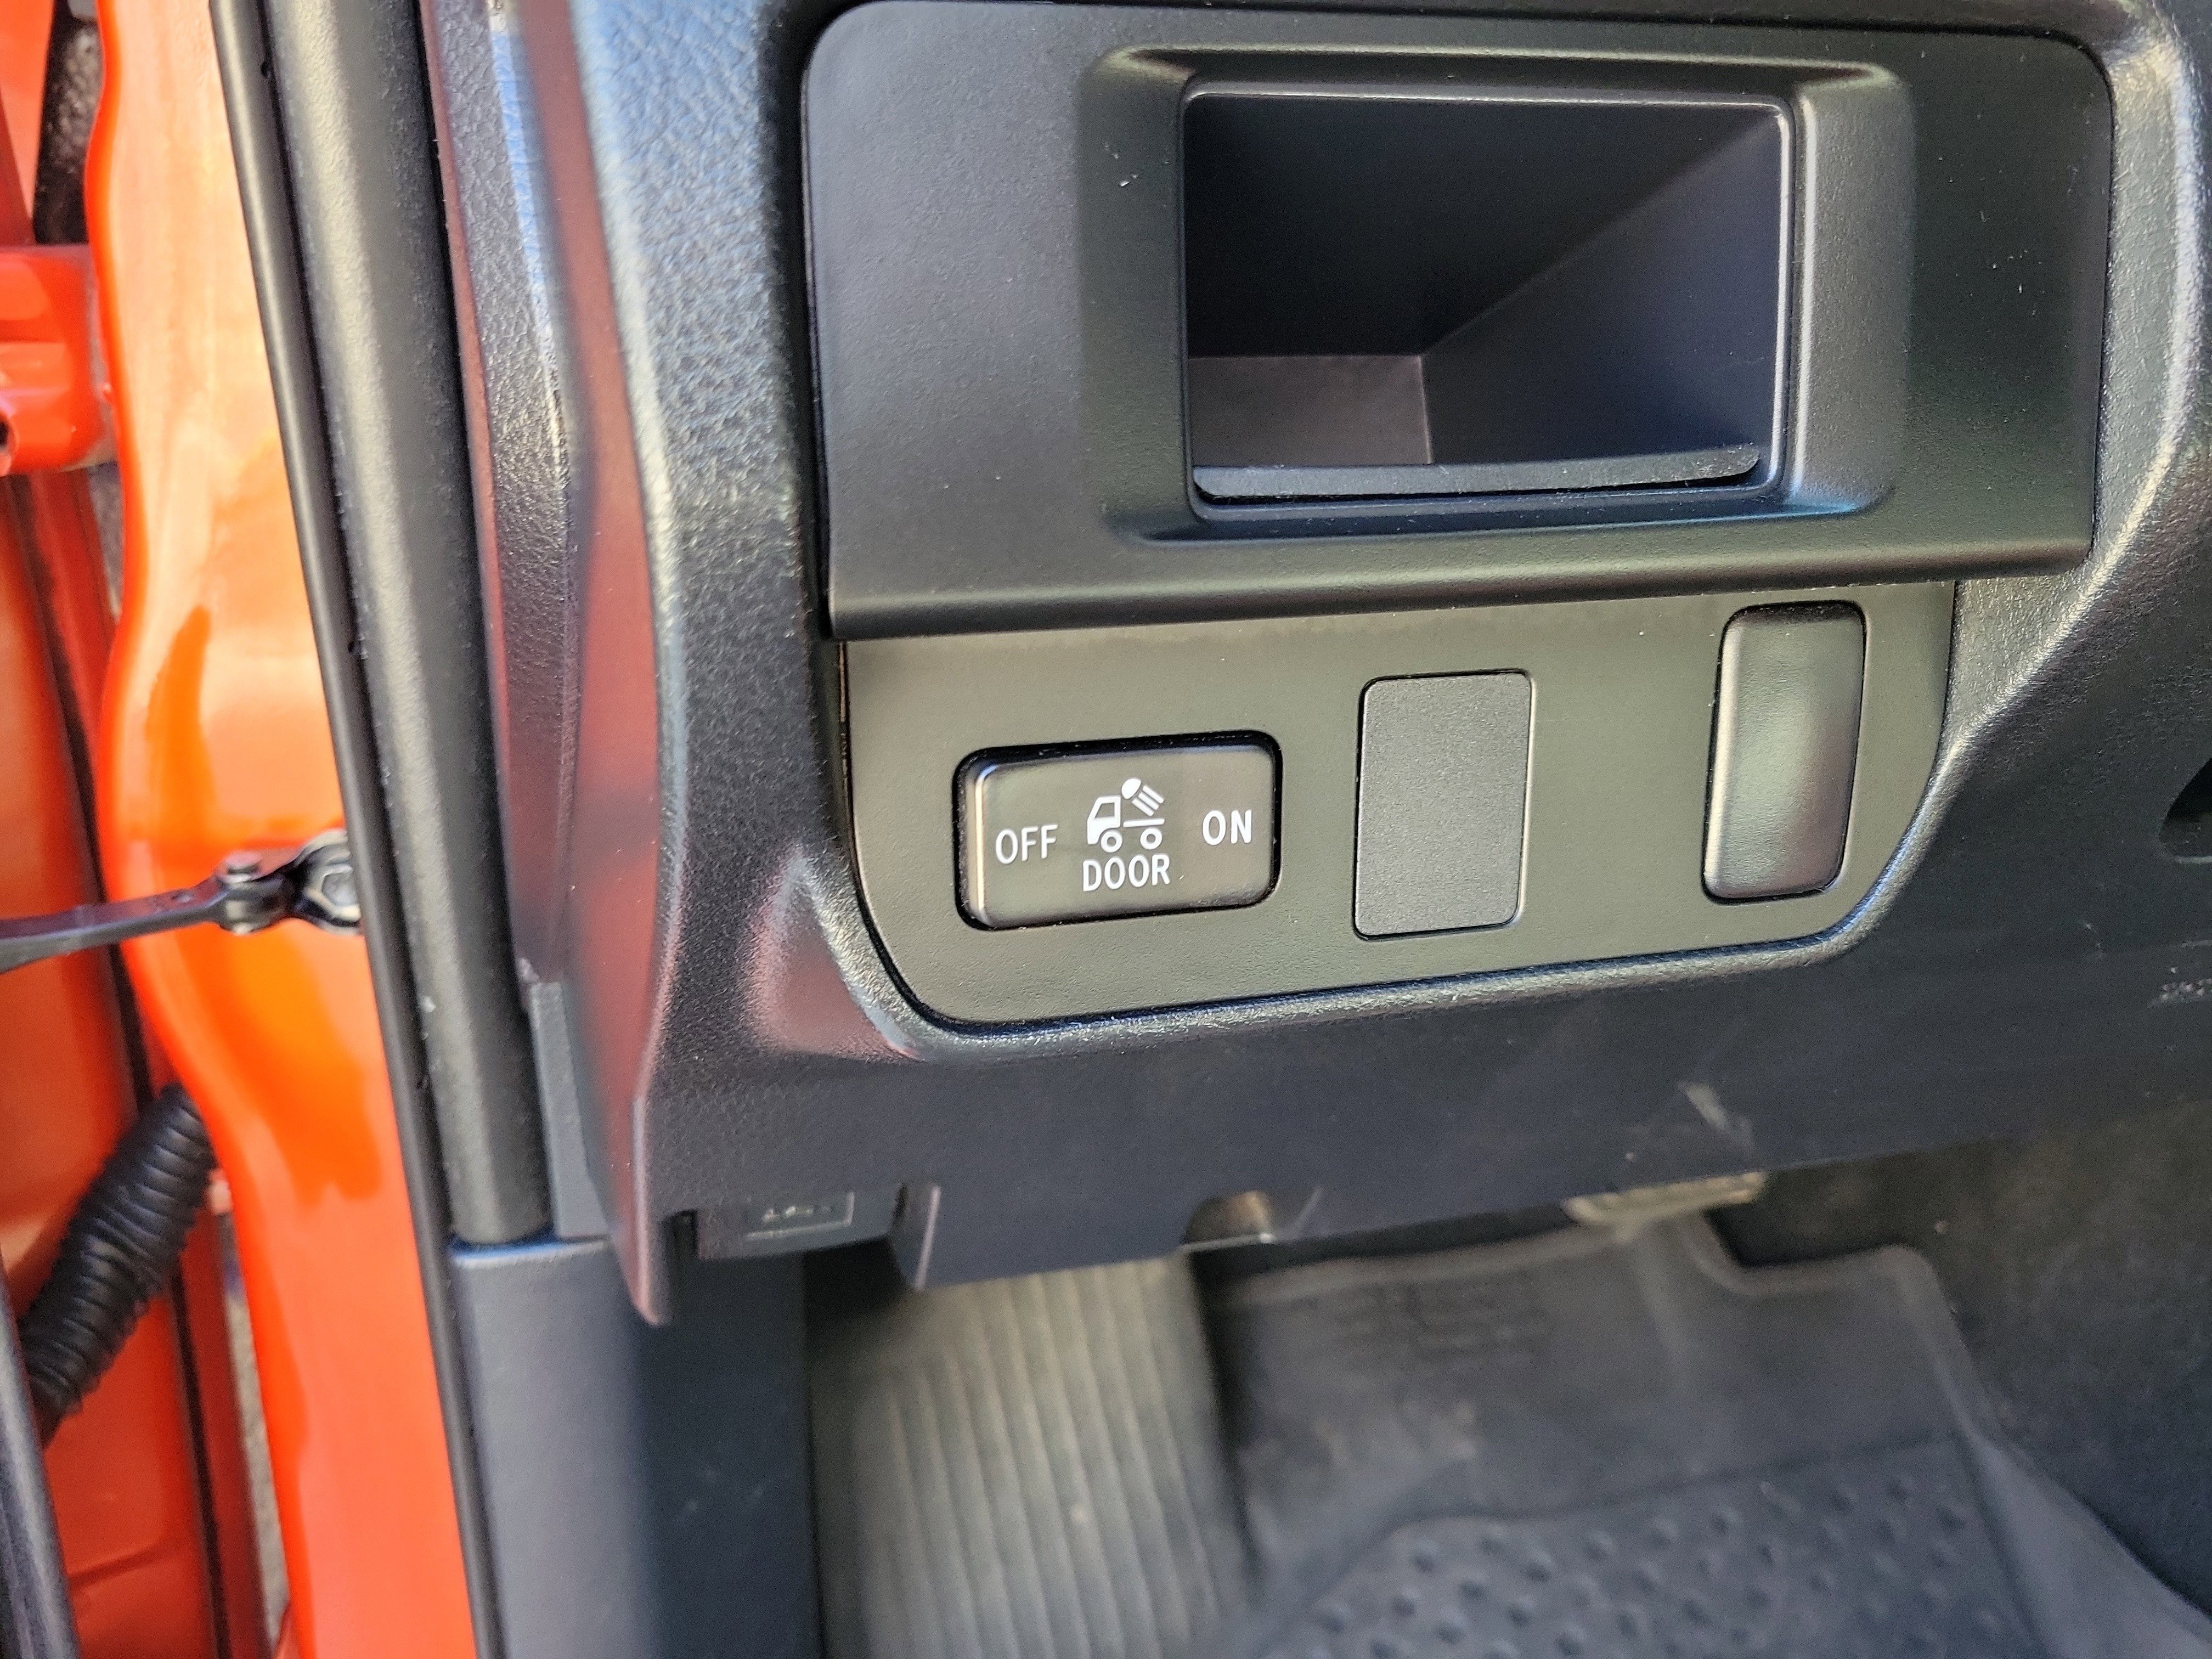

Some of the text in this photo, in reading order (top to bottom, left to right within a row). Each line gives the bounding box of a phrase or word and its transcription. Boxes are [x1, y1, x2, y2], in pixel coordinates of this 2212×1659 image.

[995, 823, 1058, 864] OFF
[1202, 809, 1252, 845] ON
[1082, 854, 1170, 892] DOOR
